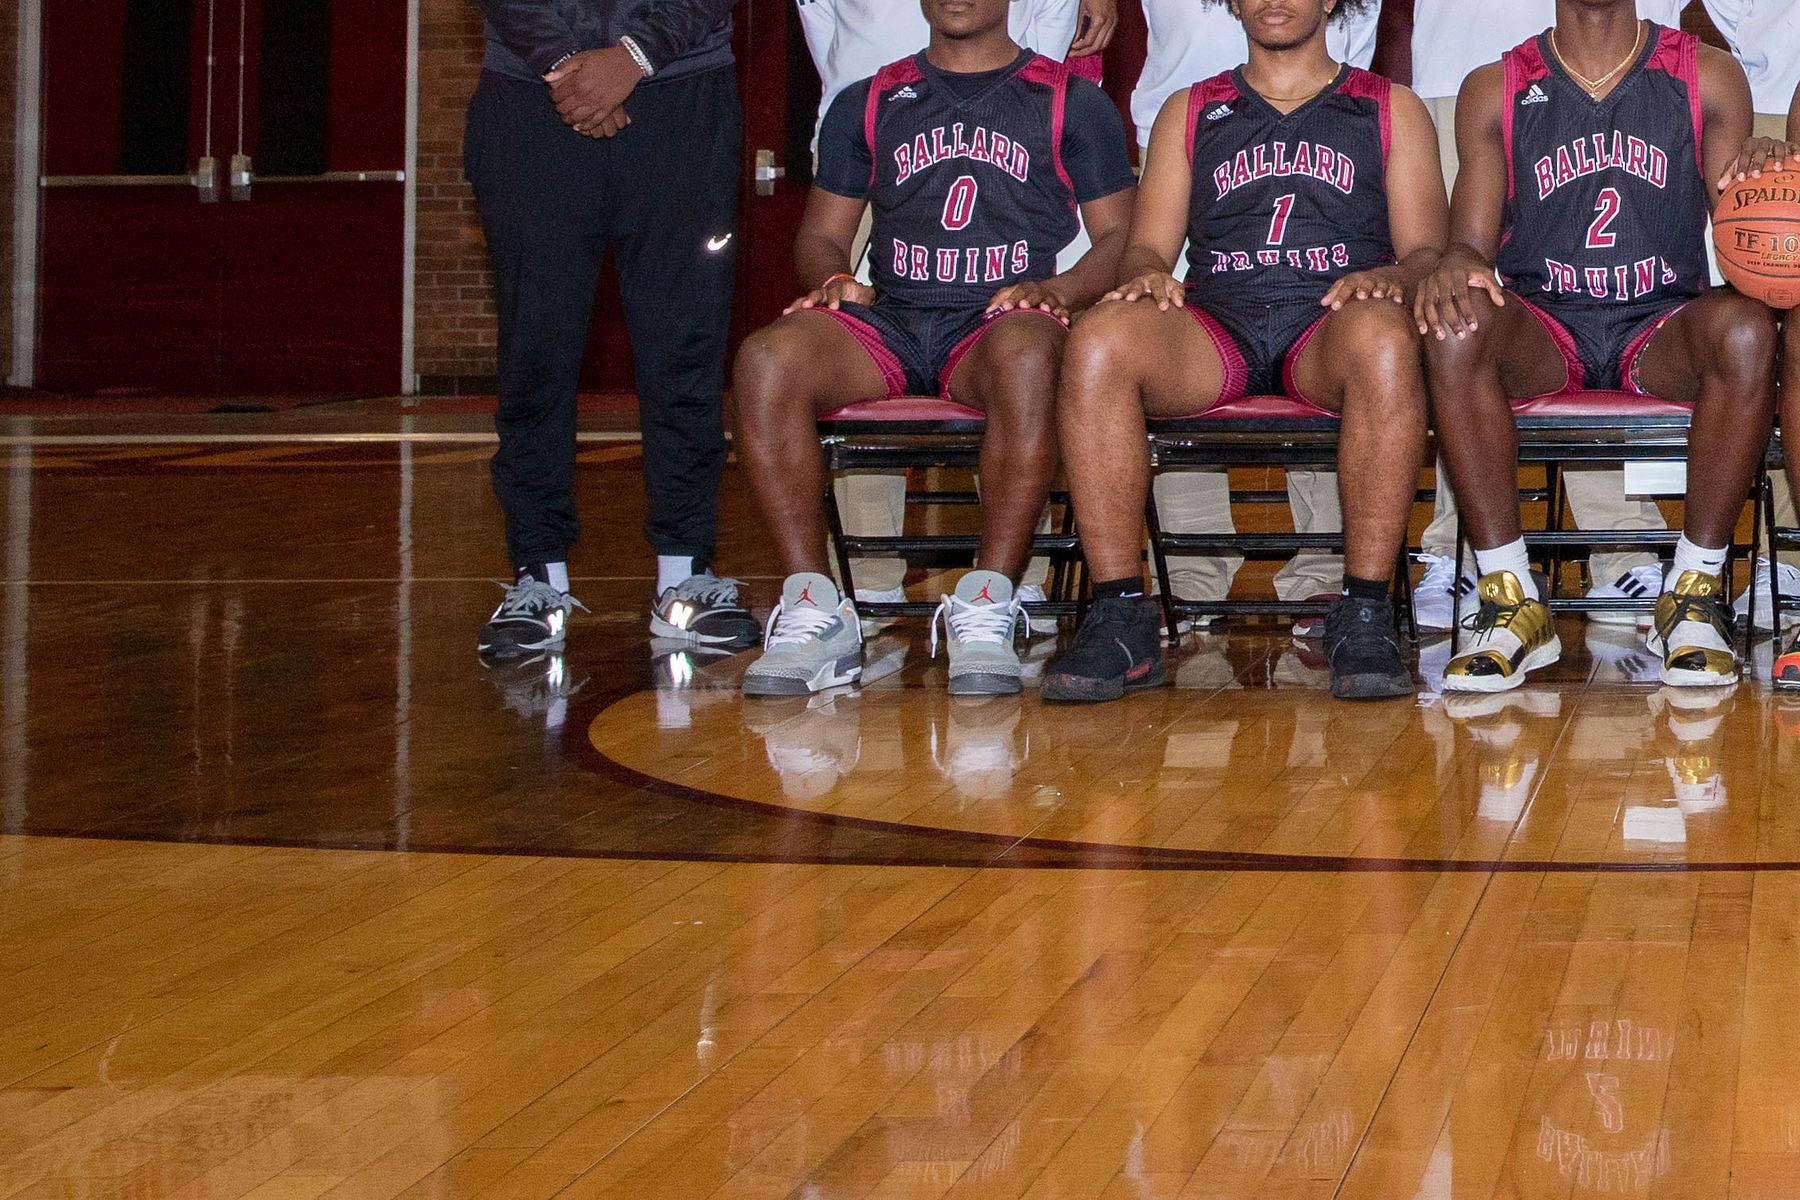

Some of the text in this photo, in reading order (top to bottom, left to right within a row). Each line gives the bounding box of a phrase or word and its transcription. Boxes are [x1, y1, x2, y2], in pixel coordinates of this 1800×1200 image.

[1521, 95, 1548, 105] adidas
[894, 123, 1029, 186] BALLARD
[1213, 141, 1355, 201] BALLARD
[1534, 129, 1667, 200] BALLARD
[941, 175, 978, 230] 0
[1266, 194, 1295, 245] 1
[1585, 187, 1621, 248] 2
[893, 238, 1028, 283] BRUINS
